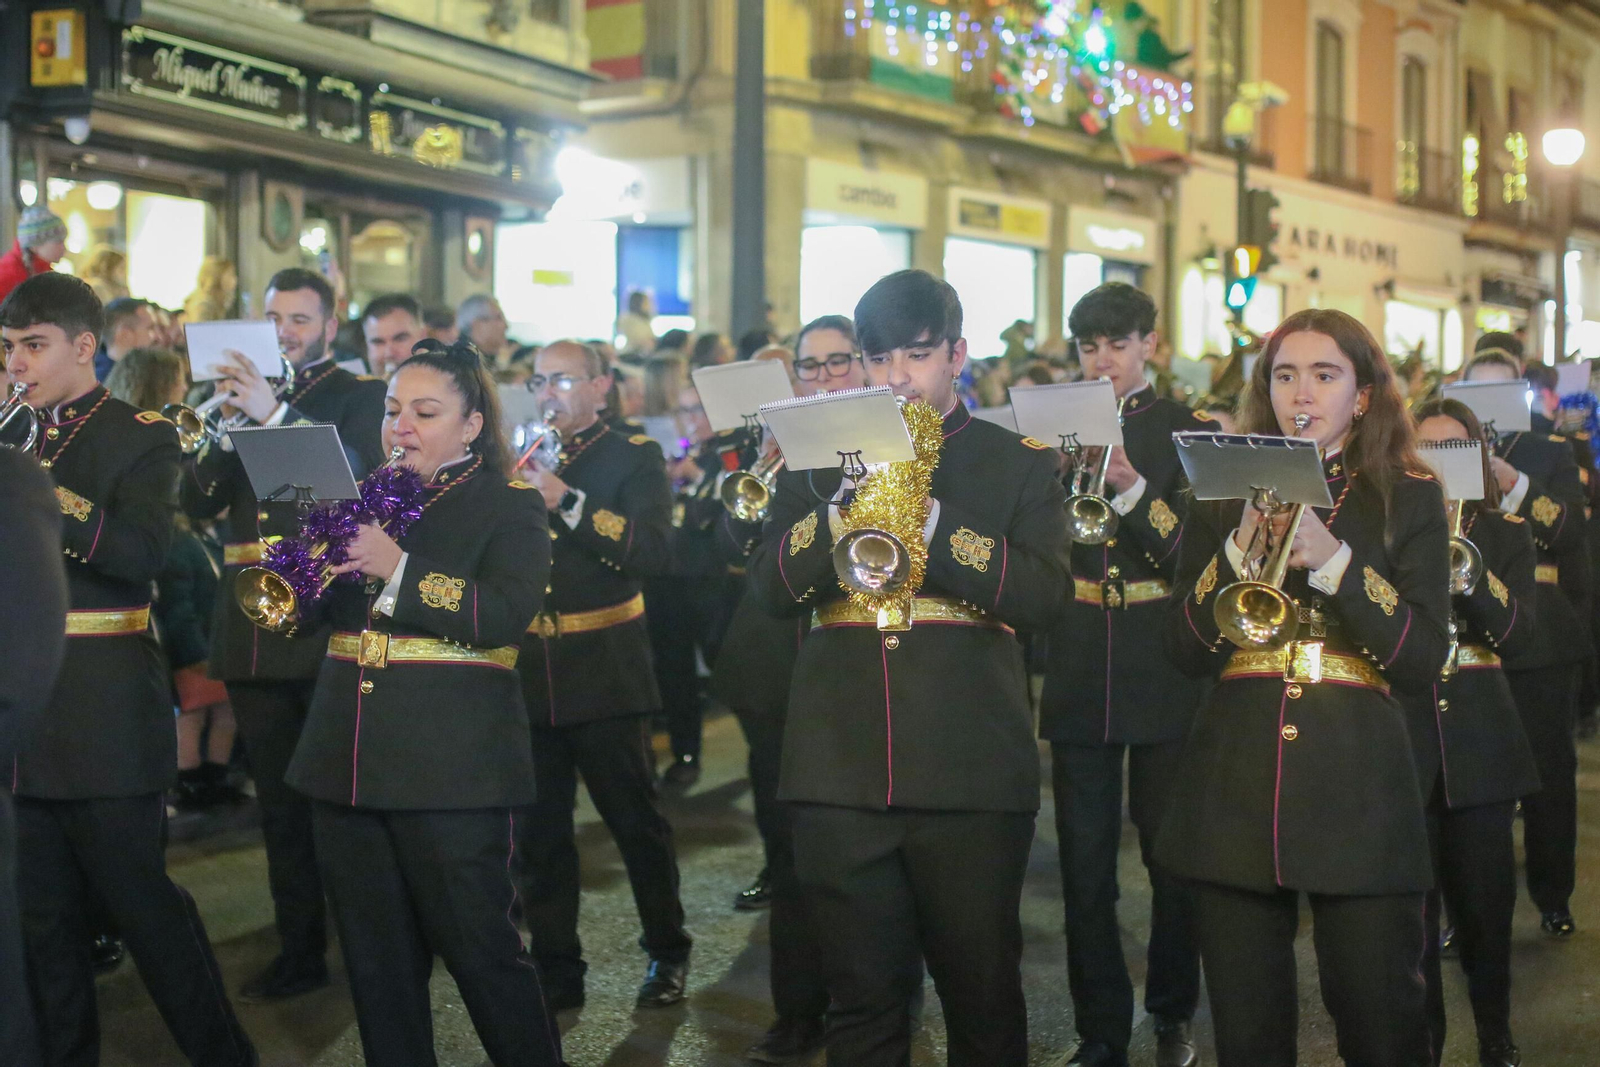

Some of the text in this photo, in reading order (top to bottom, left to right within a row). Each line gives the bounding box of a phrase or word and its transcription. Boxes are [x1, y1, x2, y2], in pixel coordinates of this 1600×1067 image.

[152, 47, 281, 109] Miguel Muñoz
[1288, 225, 1337, 255] ARA
